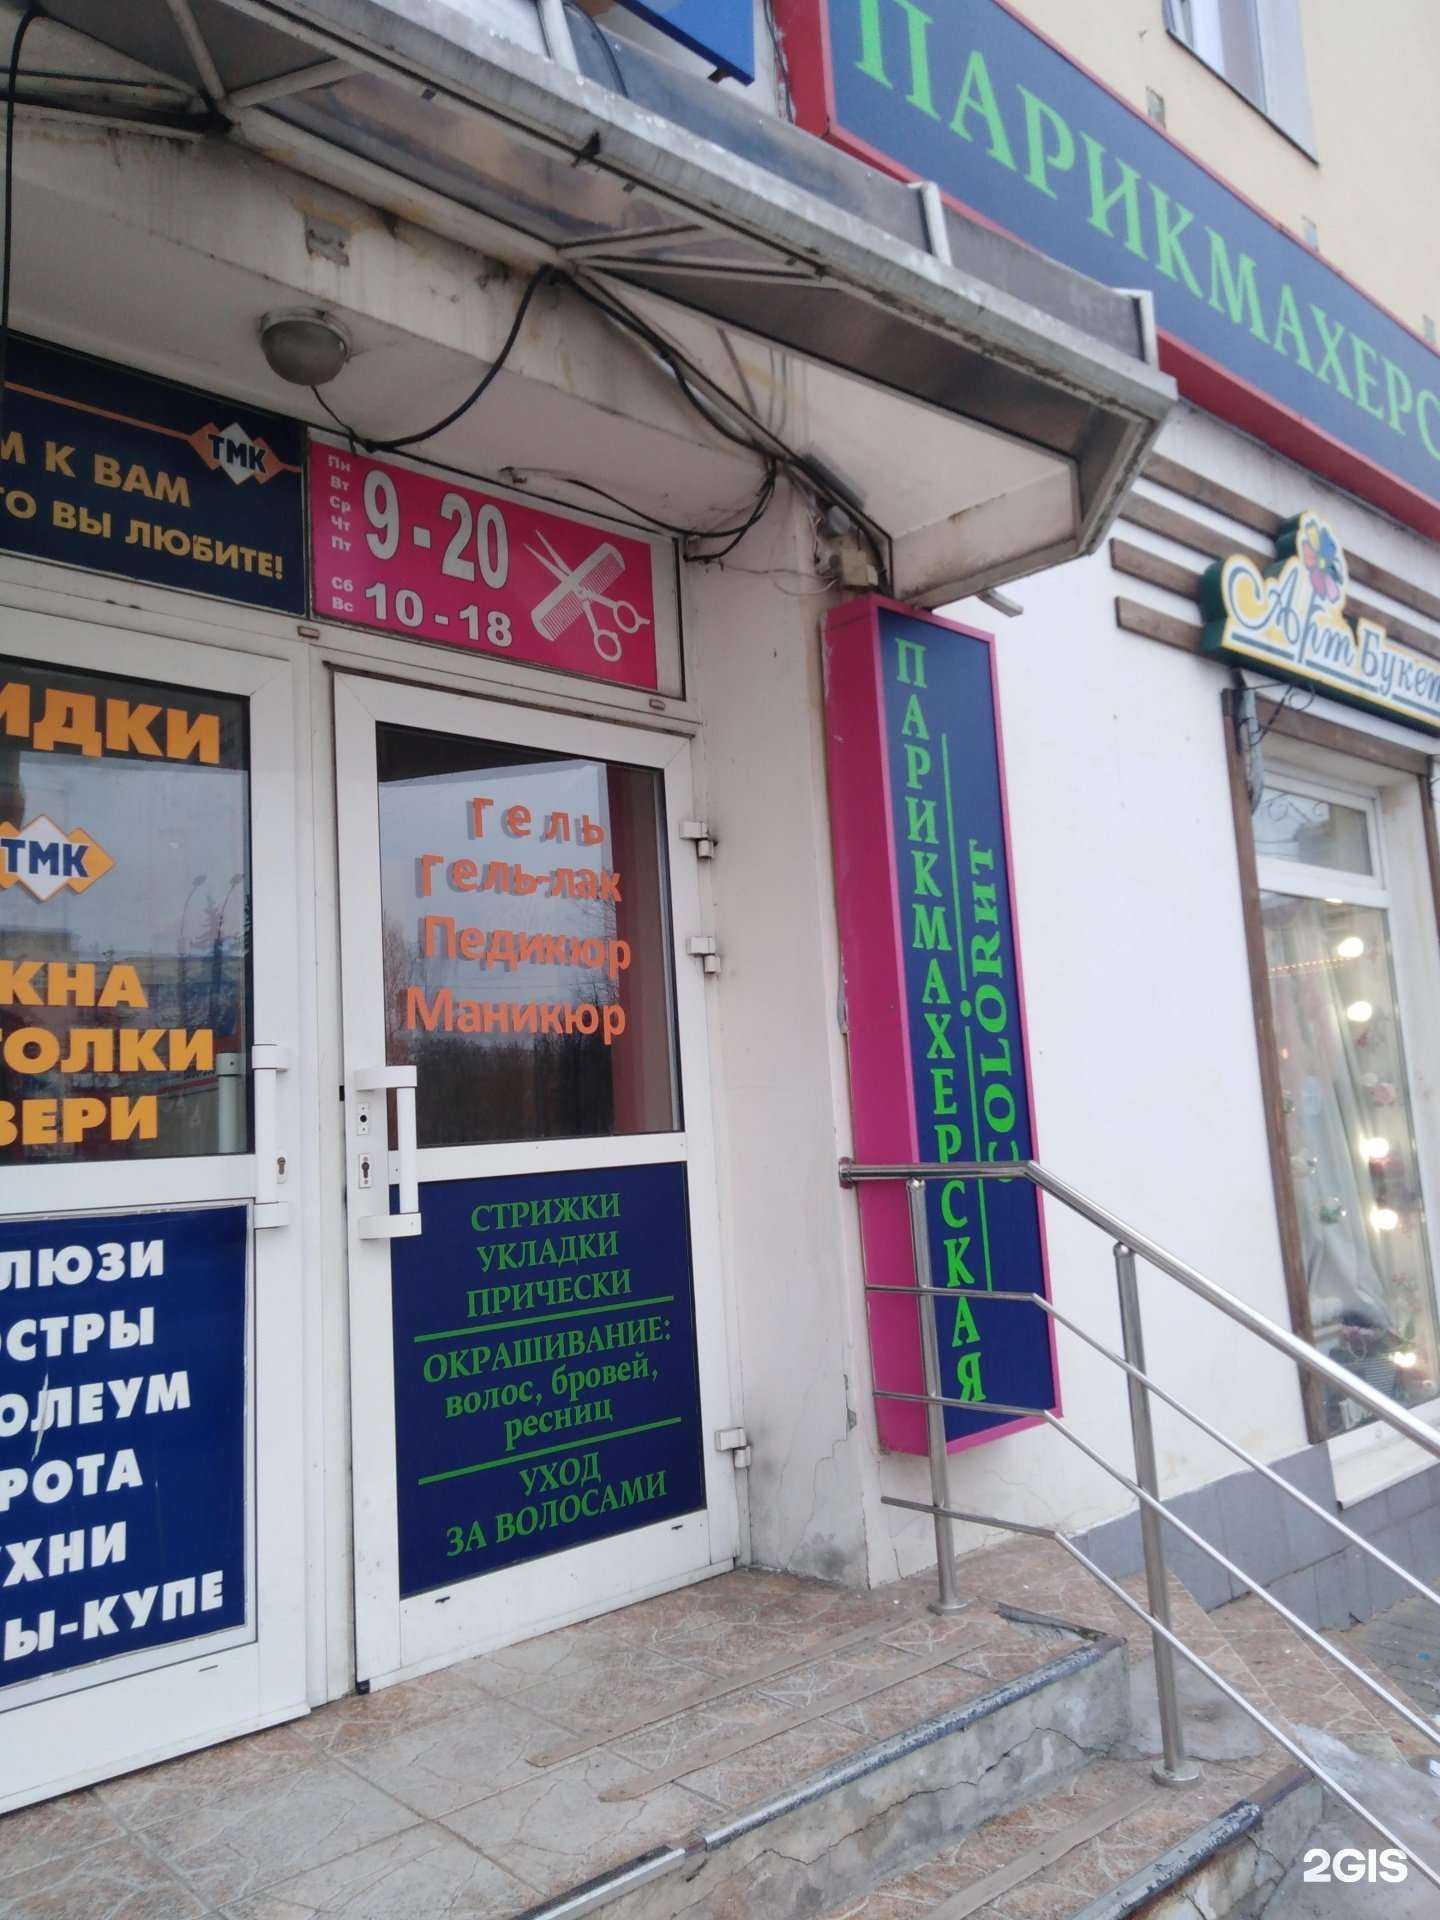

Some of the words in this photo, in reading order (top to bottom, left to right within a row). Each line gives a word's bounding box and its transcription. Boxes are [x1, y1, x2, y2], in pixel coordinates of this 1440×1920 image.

[45, 441, 76, 478] К
[94, 453, 191, 508] ВАМ
[208, 433, 266, 473] ТМК
[328, 455, 350, 472] Пн
[330, 476, 349, 491] Вт
[330, 496, 350, 512] Ср
[0, 487, 37, 519] О
[53, 501, 111, 538] ВЫ
[125, 519, 284, 580] ЛЮБИТЕ!
[331, 516, 350, 531] Чт
[332, 536, 351, 551] Пт
[331, 576, 353, 592] Сб
[332, 597, 353, 612] Вс
[471, 797, 605, 845] Гель
[1, 838, 88, 877] ТМК
[421, 854, 622, 902] Гель-лак
[424, 915, 632, 977] Педикюр
[0, 960, 148, 1008] КНА
[406, 986, 626, 1045] Маникюр
[894, 637, 985, 1403] ПАРИКМАХЕРСКАЯ
[0, 1027, 213, 1074] ОЛКИ
[471, 1193, 621, 1232] СТРИЖКИ
[0, 1240, 164, 1291] ЛЮЗИ
[476, 1231, 618, 1273] УКЛАДКИ
[466, 1269, 631, 1318] ПРИЧЕСКИ
[0, 1307, 154, 1361] СТРЫ
[424, 1316, 671, 1383] ОКРАШИВАНИЕ:
[445, 1380, 541, 1418] волос,
[551, 1353, 658, 1401] бровей,
[504, 1399, 613, 1451] ресниц
[0, 1448, 142, 1512] РОТА
[519, 1452, 601, 1497] УХОД
[446, 1521, 487, 1557] ЗА
[496, 1471, 667, 1544] ВОЛОСАМИ
[0, 1521, 126, 1587] ХНИ
[4, 1571, 223, 1661] Ы-КУПЕ
